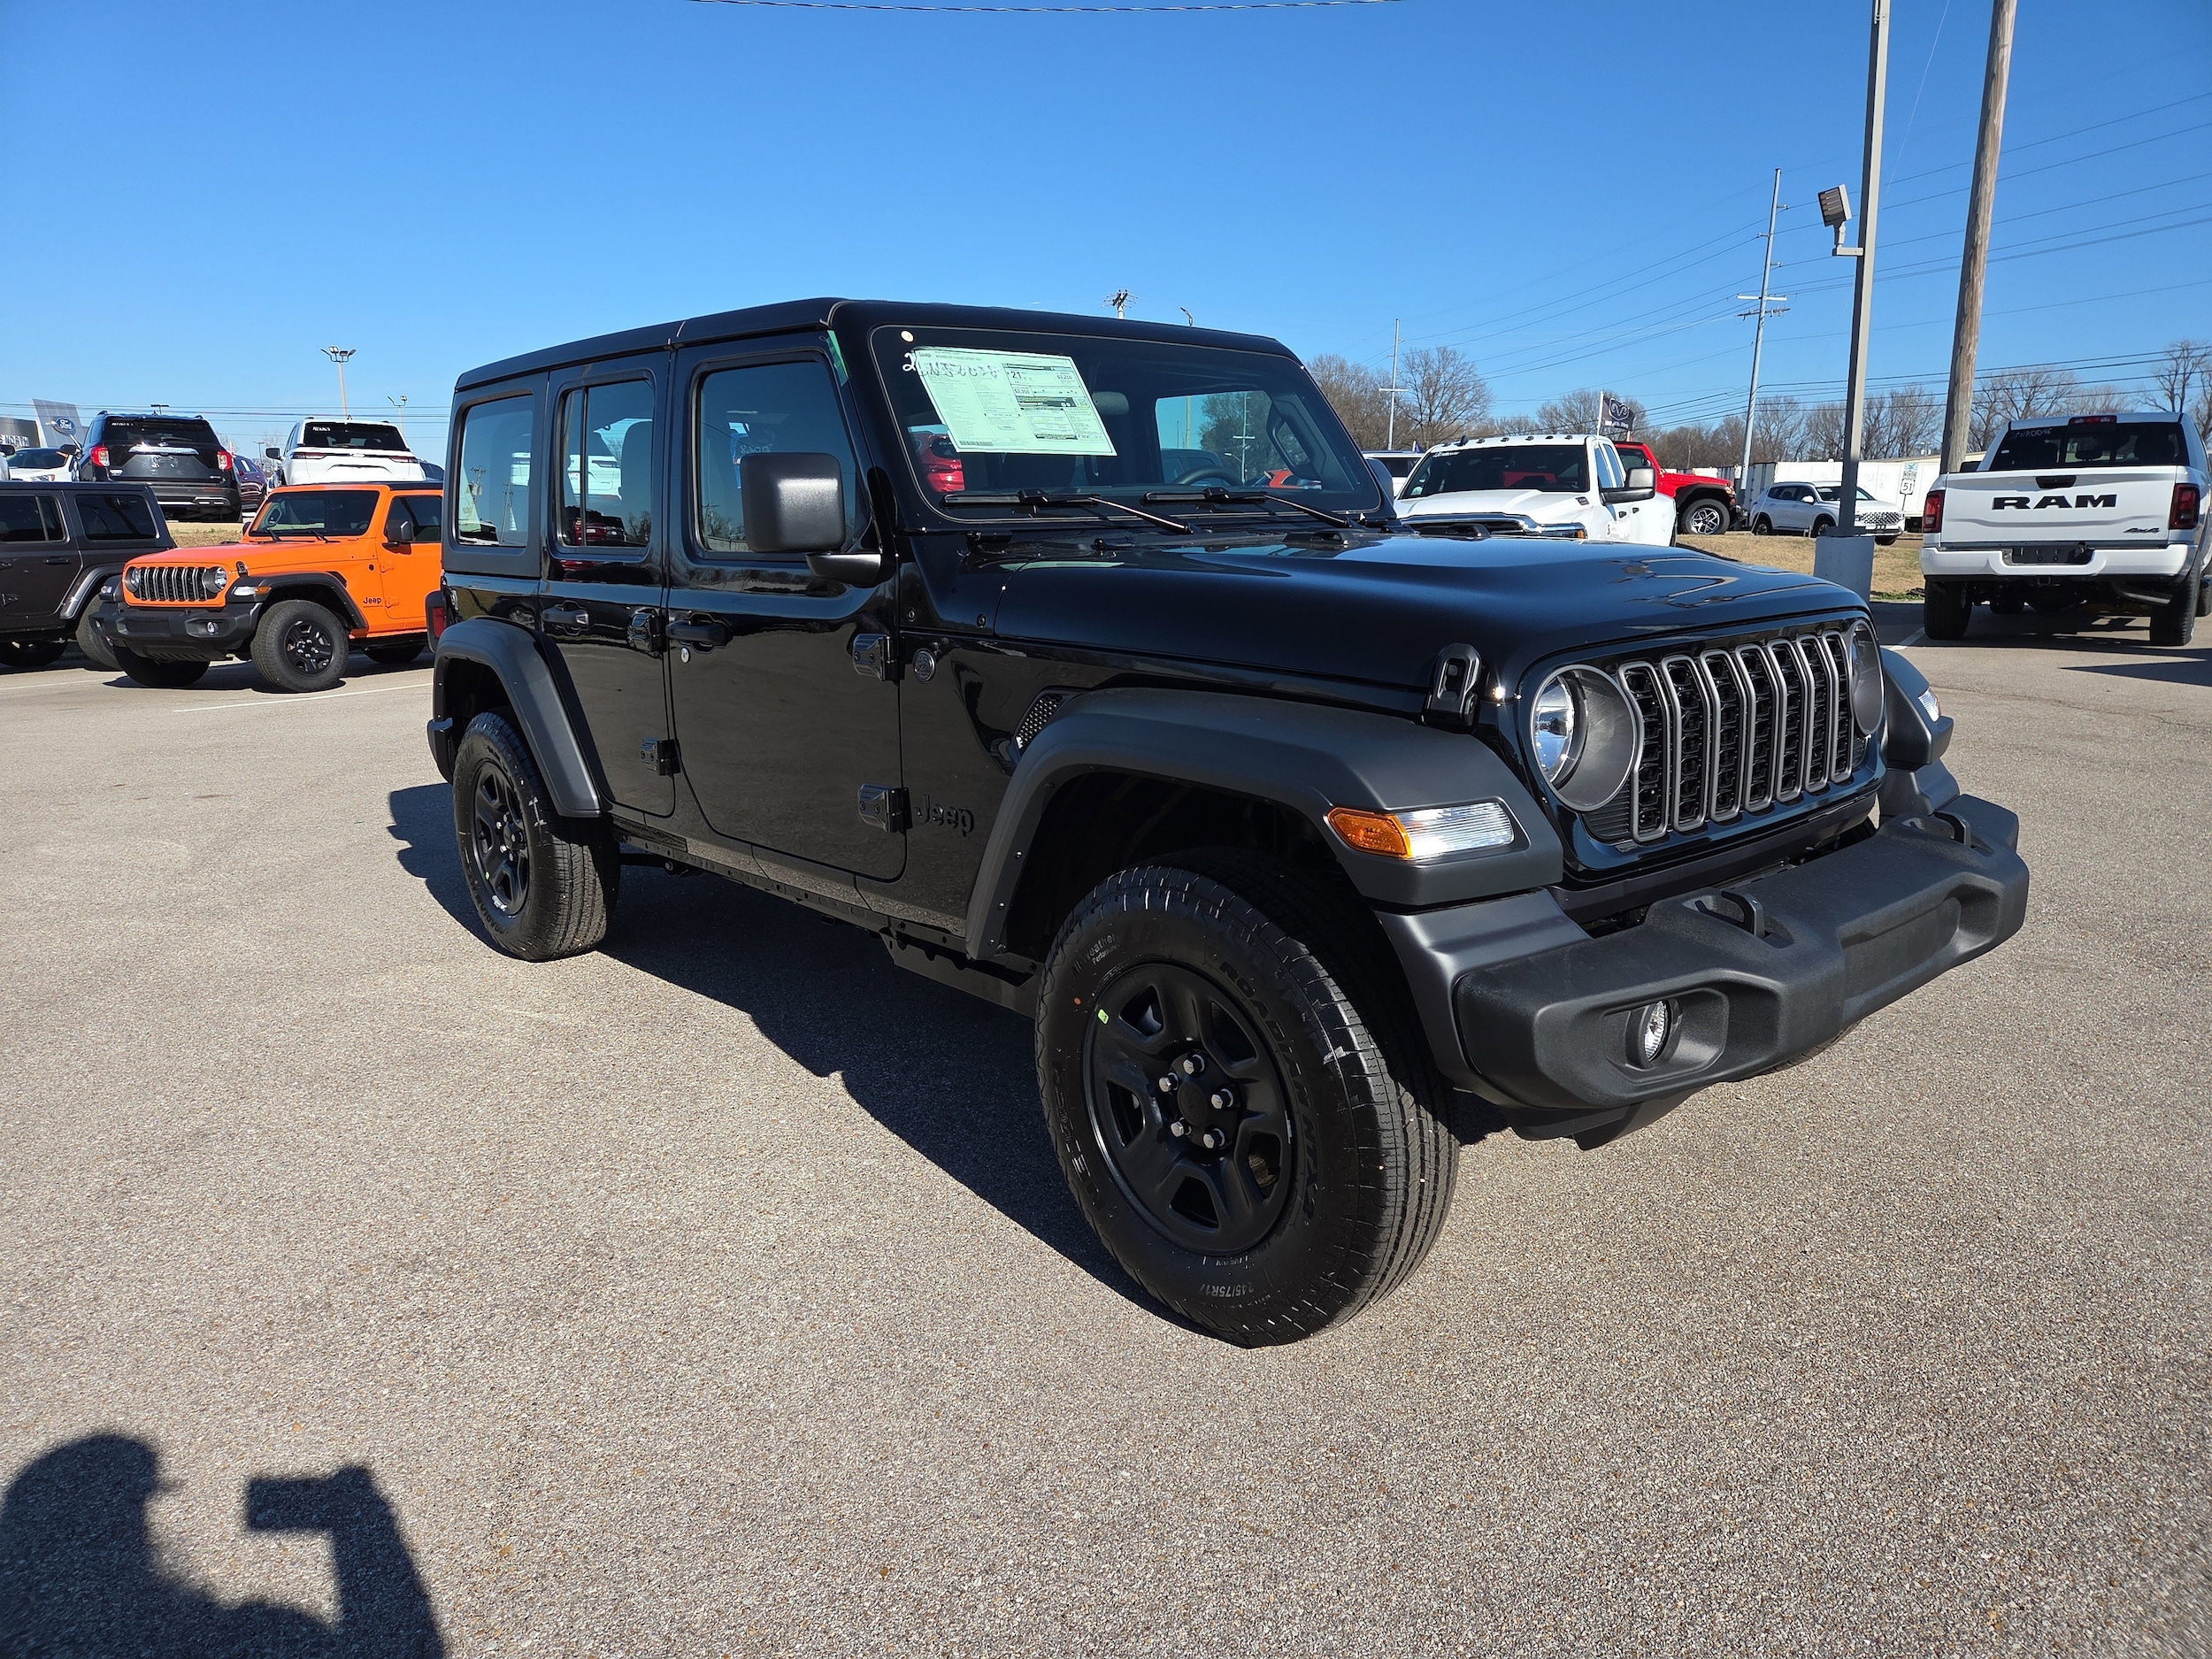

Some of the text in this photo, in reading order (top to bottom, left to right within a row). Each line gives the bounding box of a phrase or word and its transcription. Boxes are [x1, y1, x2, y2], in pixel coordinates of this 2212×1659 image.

[1010, 371, 1022, 380] 21
[1902, 482, 1912, 491] 51
[1992, 494, 2118, 511] RAM
[913, 793, 975, 838] Jeep
[1218, 958, 1312, 1109] ROADIAN
[1197, 1280, 1255, 1299] 245/75R17
